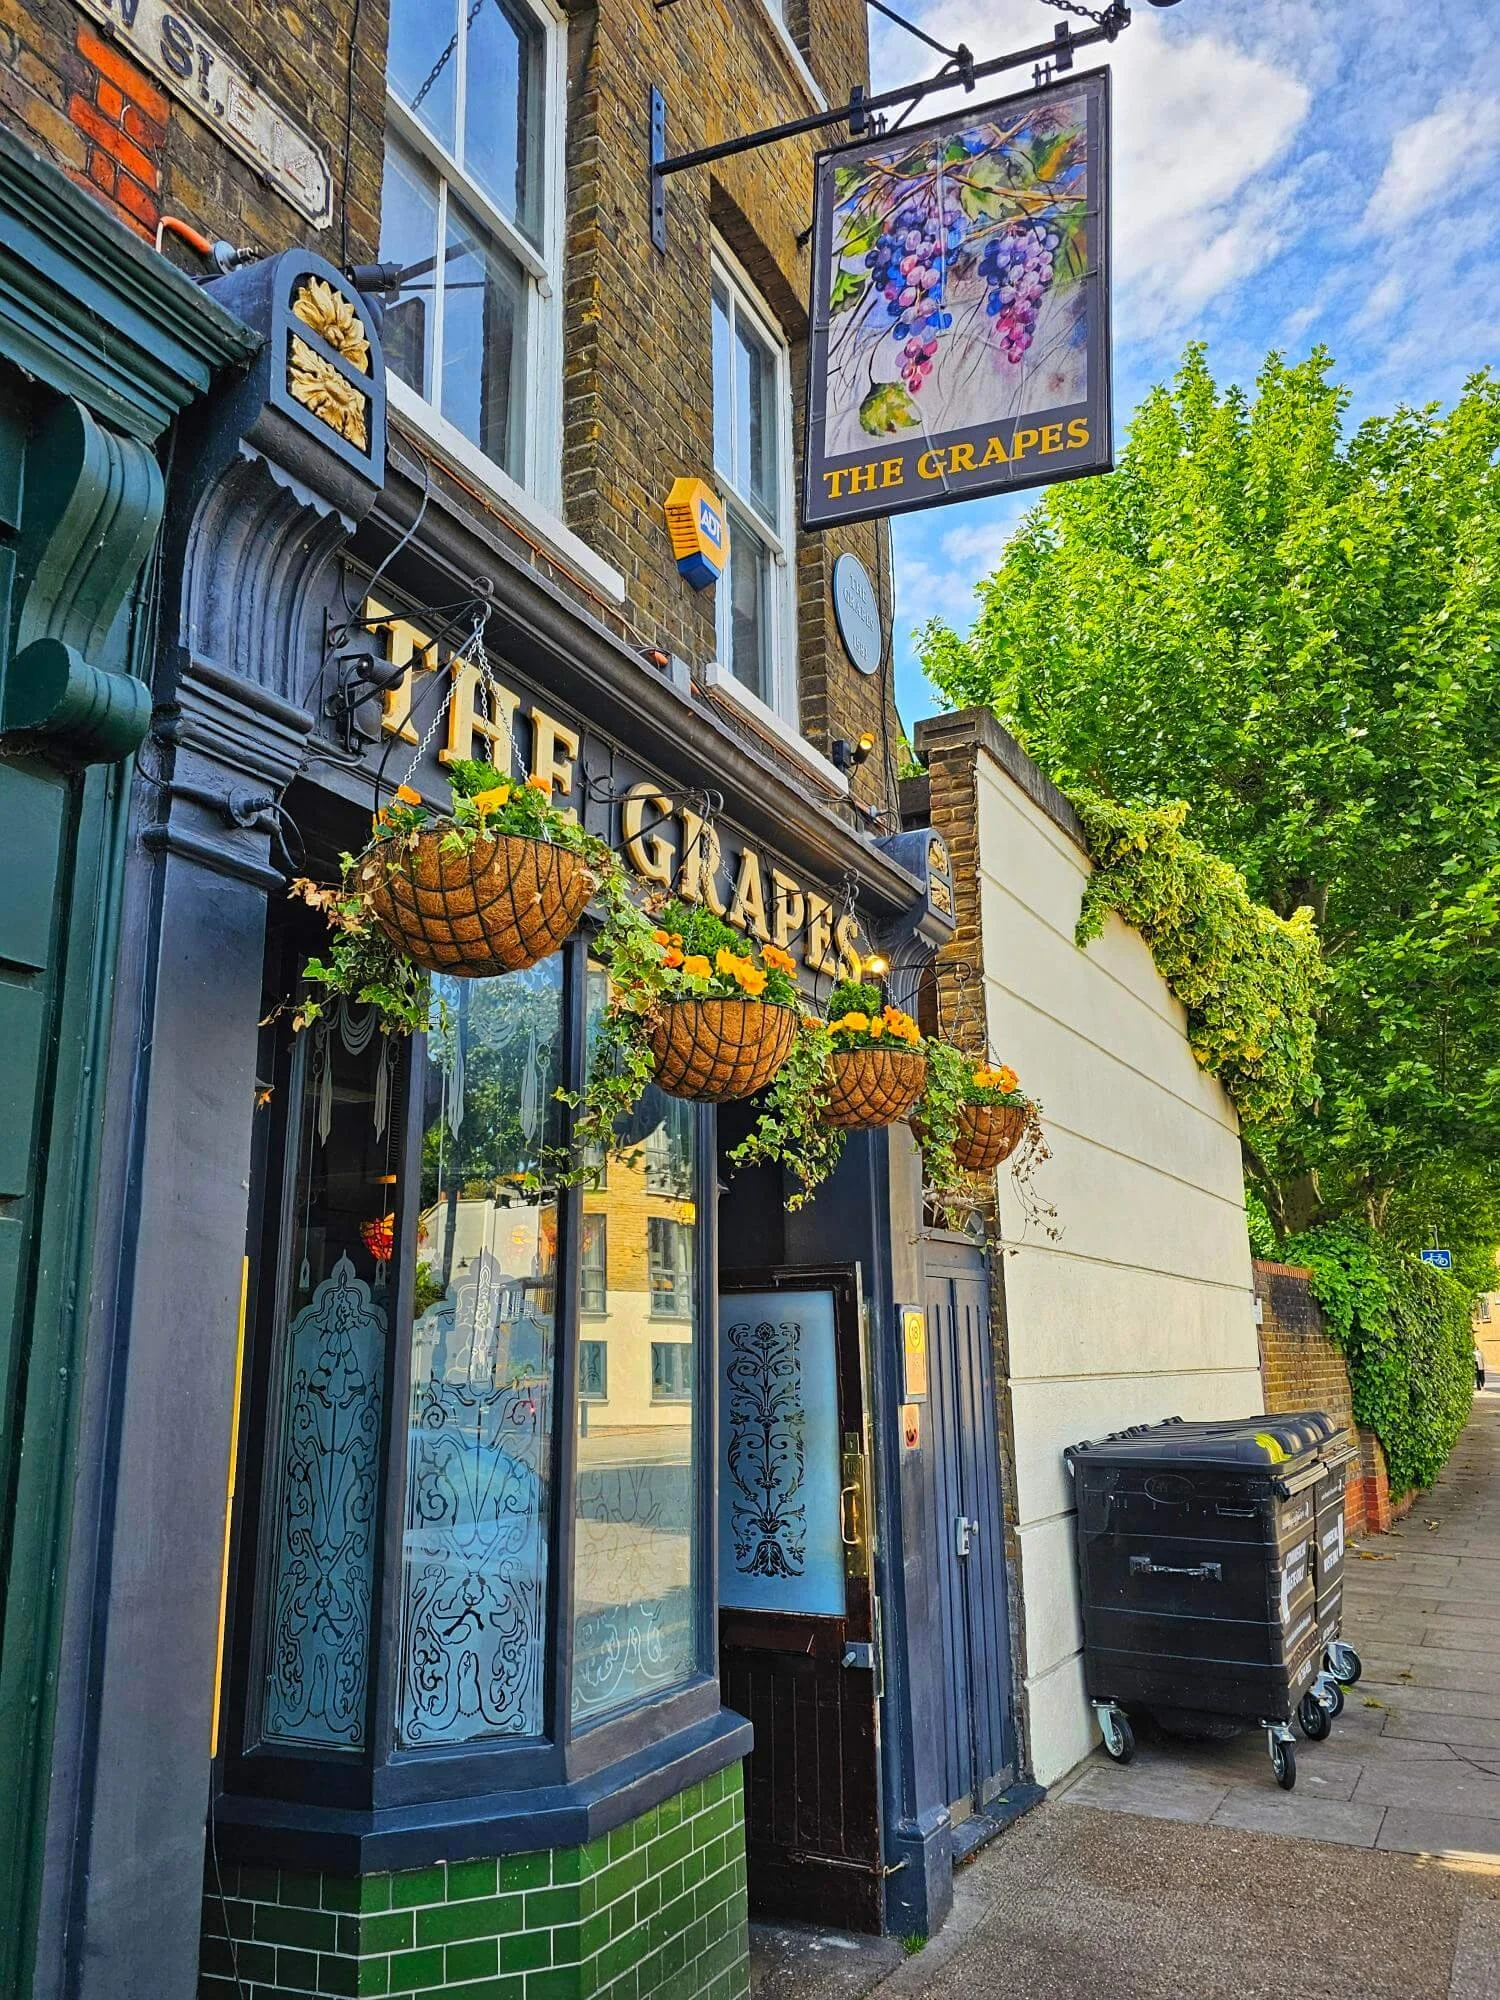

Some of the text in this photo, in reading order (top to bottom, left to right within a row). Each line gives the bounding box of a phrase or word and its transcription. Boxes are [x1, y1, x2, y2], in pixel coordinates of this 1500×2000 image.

[823, 418, 1090, 499] THE GRAPES
[701, 508, 721, 542] ADT
[362, 596, 862, 986] THE GRAPES
